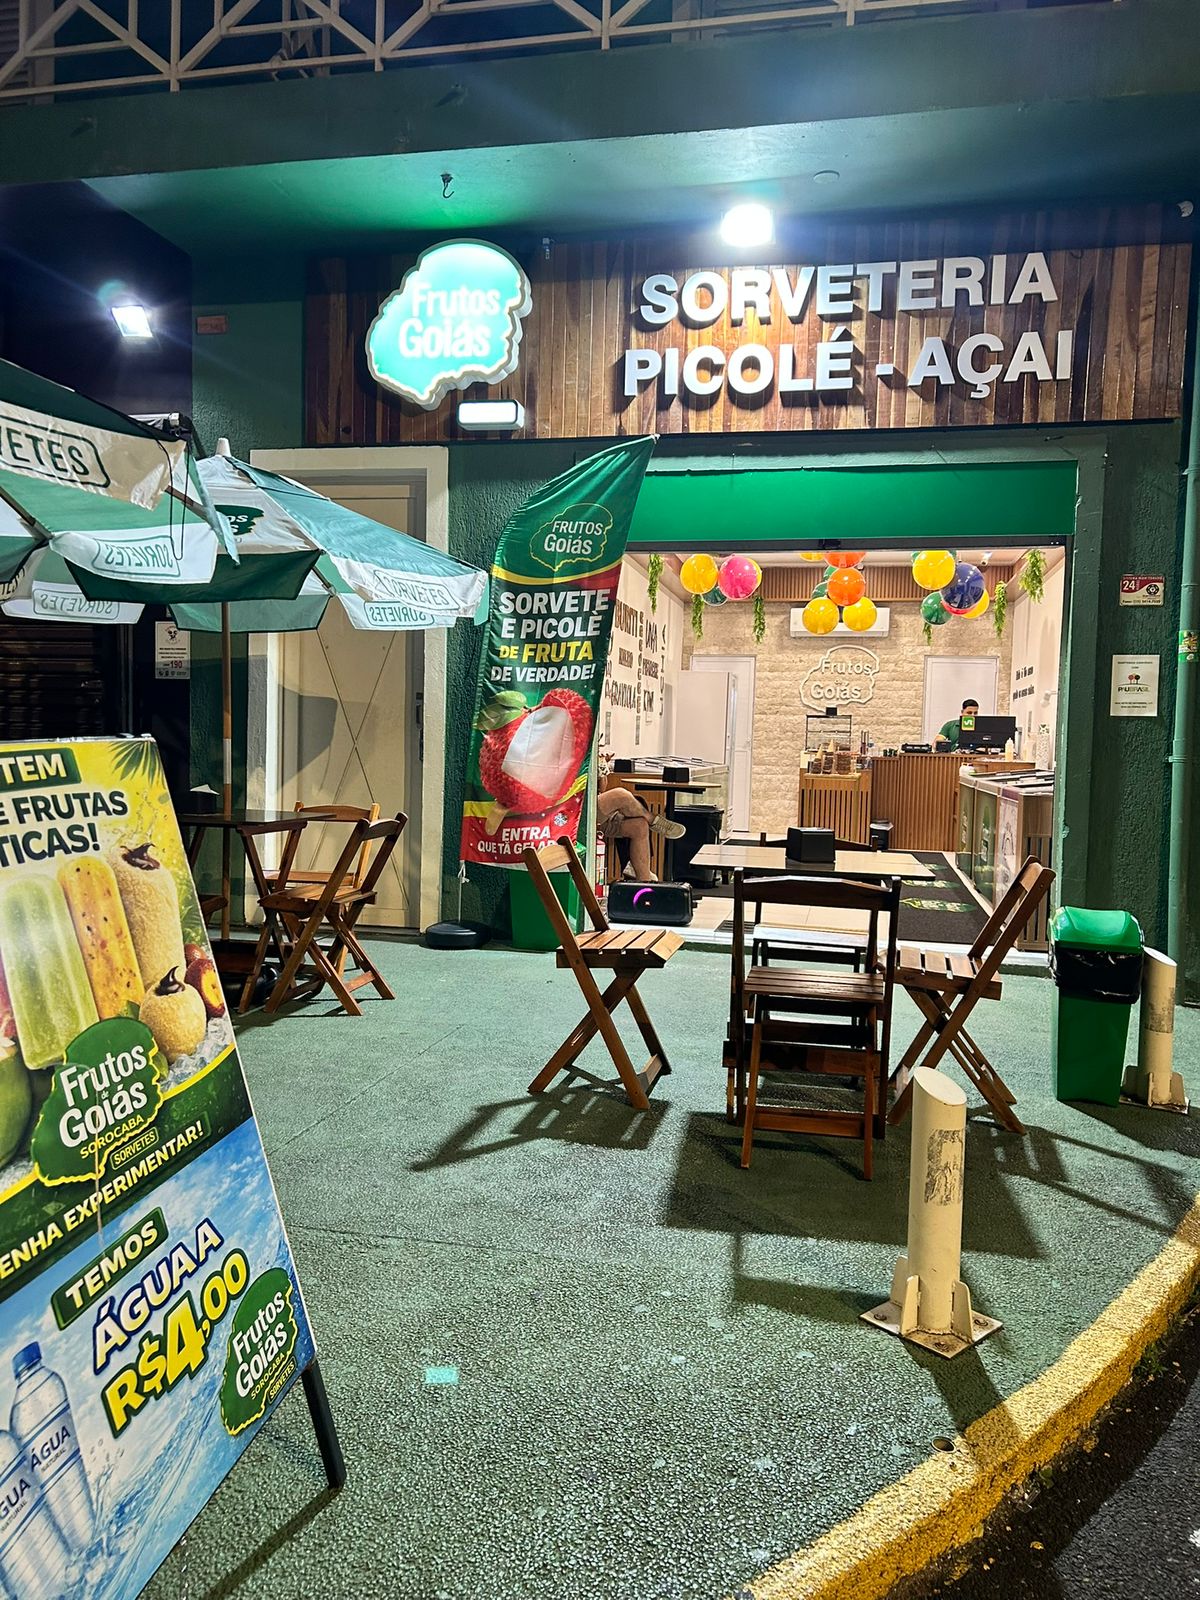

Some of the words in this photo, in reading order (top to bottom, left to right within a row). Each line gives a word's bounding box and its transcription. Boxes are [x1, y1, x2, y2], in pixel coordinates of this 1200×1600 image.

[411, 281, 500, 318] Frutos
[639, 251, 1059, 325] SORVETERIA
[398, 317, 492, 358] Goiás
[623, 327, 854, 397] PICOLÉ
[907, 329, 1074, 399] AÇAI
[0, 426, 89, 476] ETES
[543, 533, 593, 555] Goiás
[551, 520, 604, 536] FRUTOS
[498, 588, 612, 615] SORVETE
[1122, 580, 1136, 591] 24
[500, 618, 517, 639] E
[170, 660, 183, 669] 190
[498, 645, 520, 660] DE
[521, 640, 594, 664] FRUTA
[821, 659, 872, 675] Frutos
[490, 667, 512, 683] DE
[515, 663, 596, 683] VERDADE!
[810, 681, 861, 700] Goiás
[0, 752, 68, 785] TEM
[11, 790, 129, 825] FRUTAS
[0, 822, 101, 868] TICAS!
[477, 840, 498, 854] QUE
[501, 825, 551, 842] ENTRA
[59, 1044, 148, 1107] Frutos
[58, 1081, 148, 1148] Goiás
[79, 1113, 145, 1160] SOROCABA
[112, 1131, 158, 1166] SORVETES
[63, 1119, 204, 1233] EXPERIMENTAR!
[65, 1219, 158, 1309] TEMOS
[93, 1243, 197, 1372] ÁGUA
[197, 1219, 223, 1264] A
[103, 1250, 248, 1434] R$4,00
[232, 1291, 285, 1365] Frutos
[235, 1322, 288, 1398] Goiás
[250, 1352, 285, 1401] SOROCABA
[268, 1360, 296, 1400] SORVETES
[30, 1425, 71, 1472] ÁGUA
